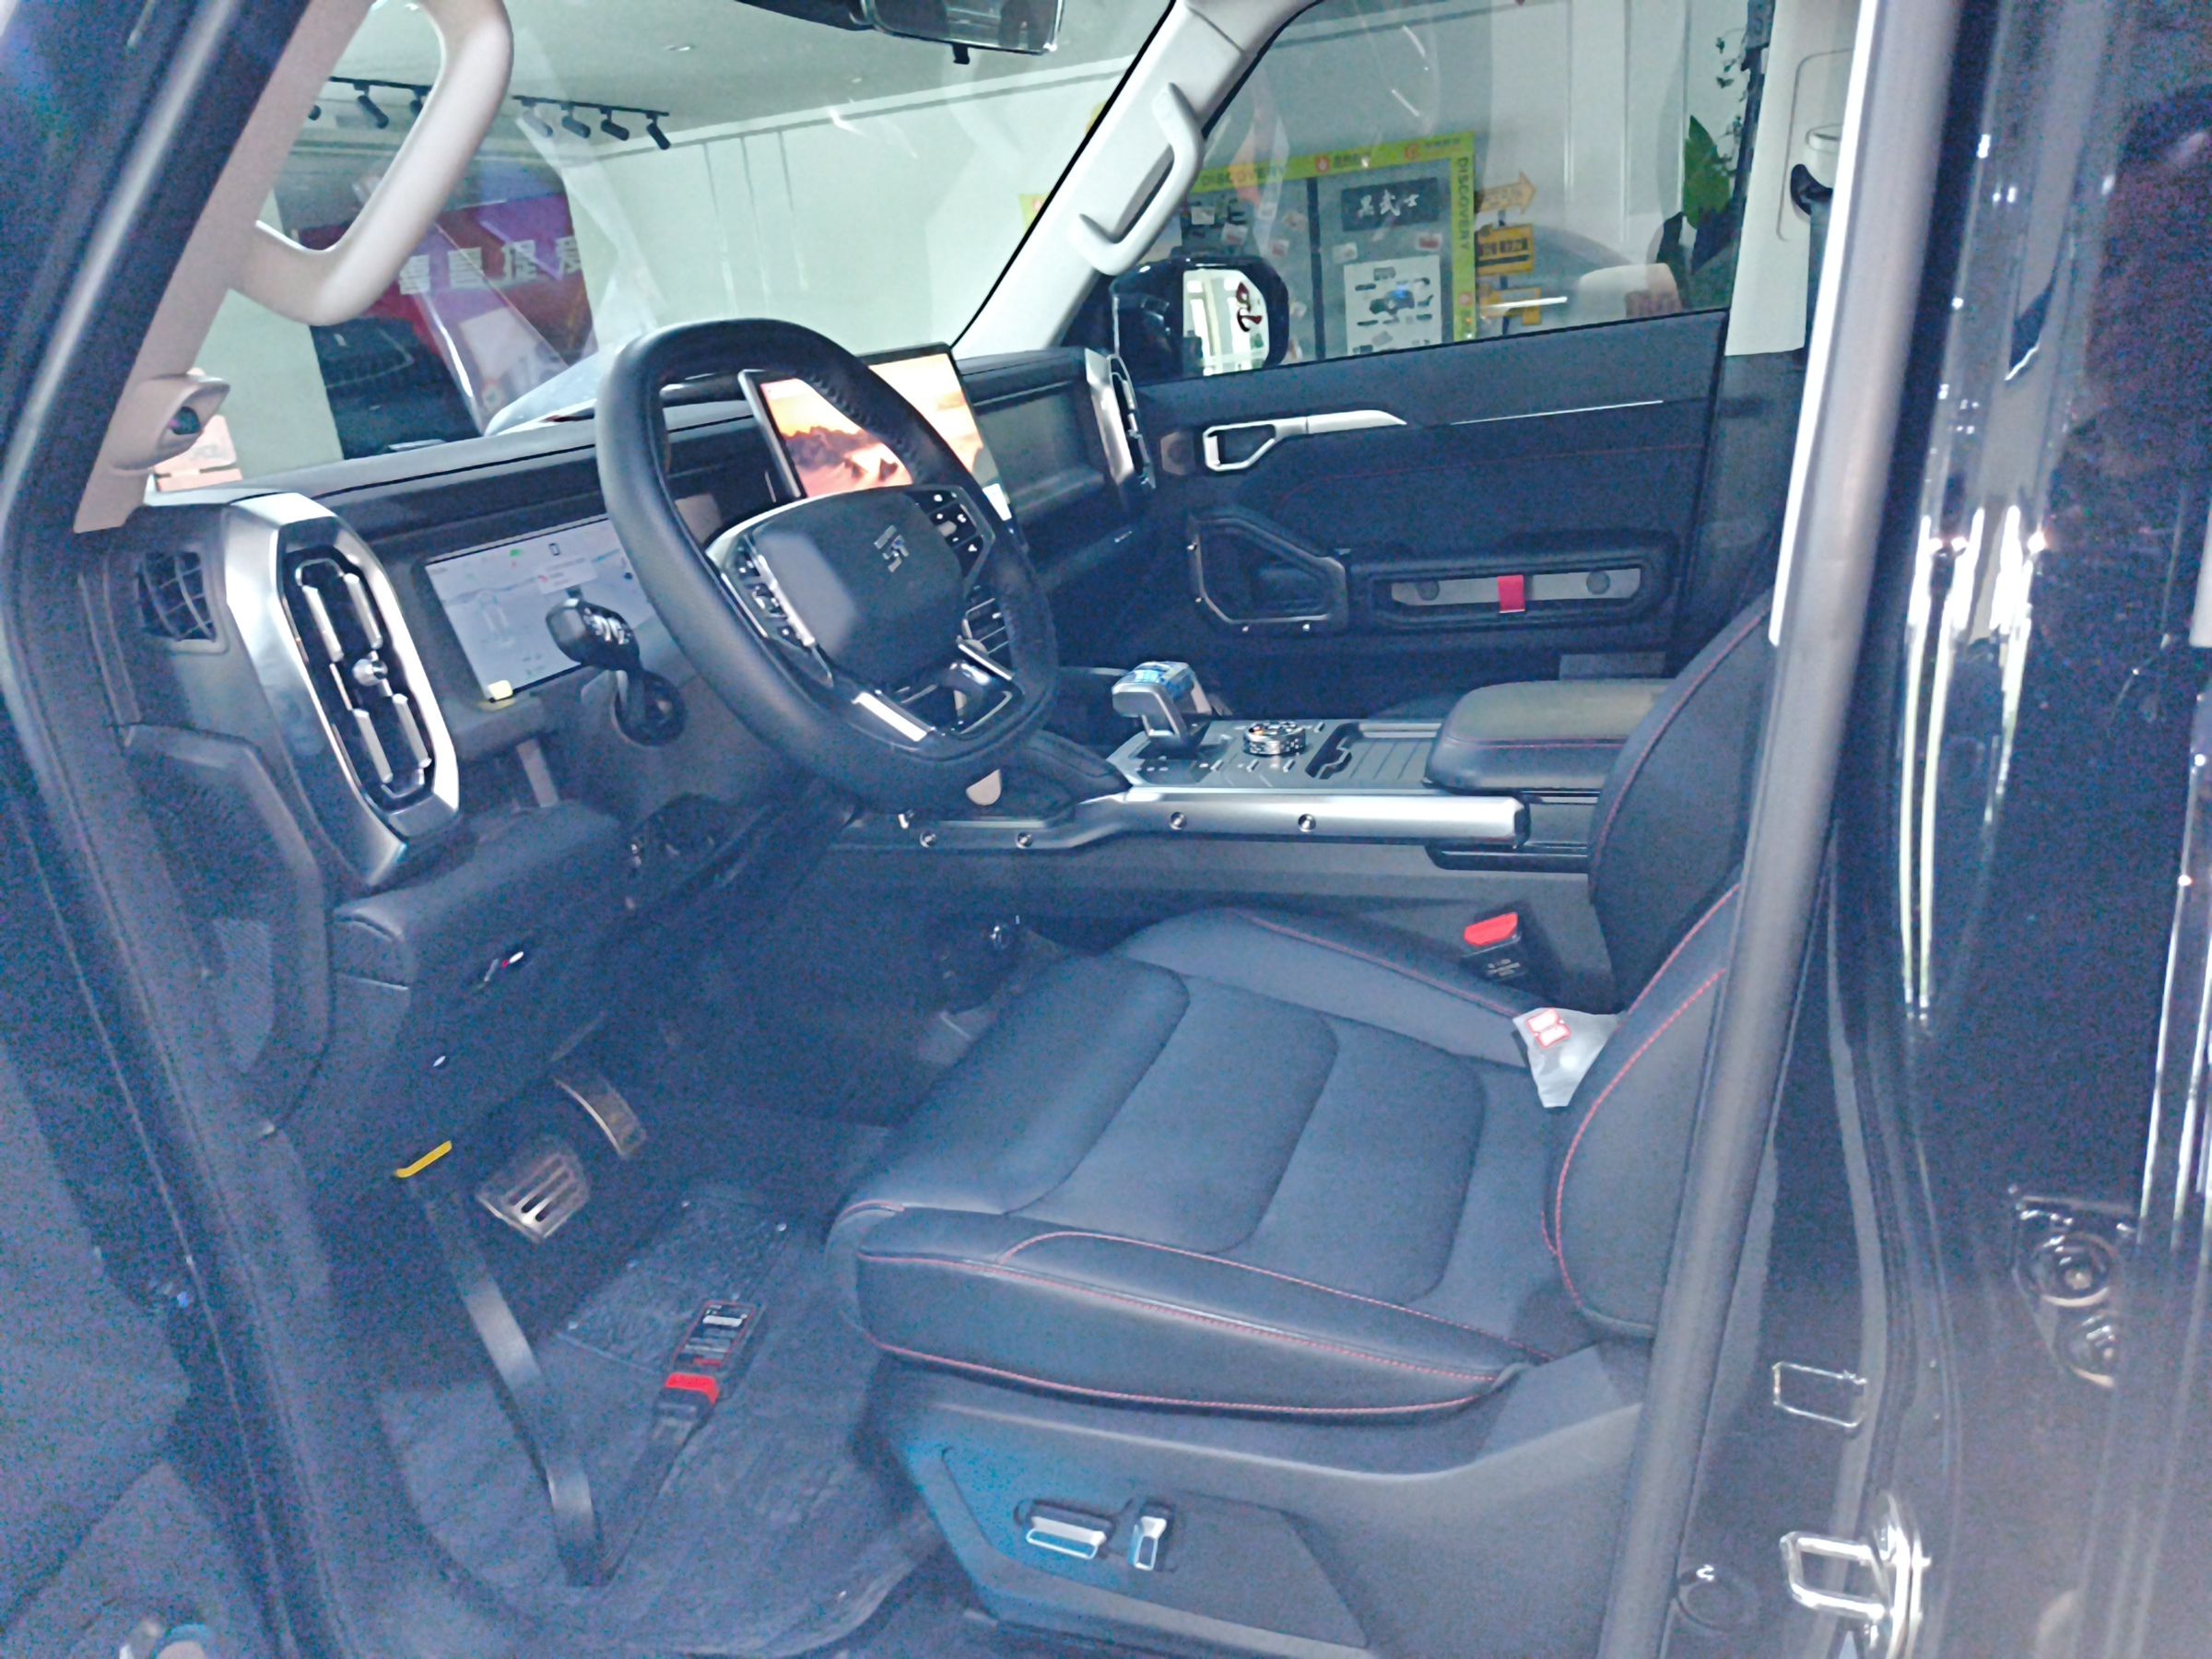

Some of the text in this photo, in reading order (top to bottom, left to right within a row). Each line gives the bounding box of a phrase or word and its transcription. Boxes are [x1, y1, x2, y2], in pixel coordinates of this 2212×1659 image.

[1358, 188, 1420, 218] 黑武士
[1458, 157, 1470, 250] DISCOVERY
